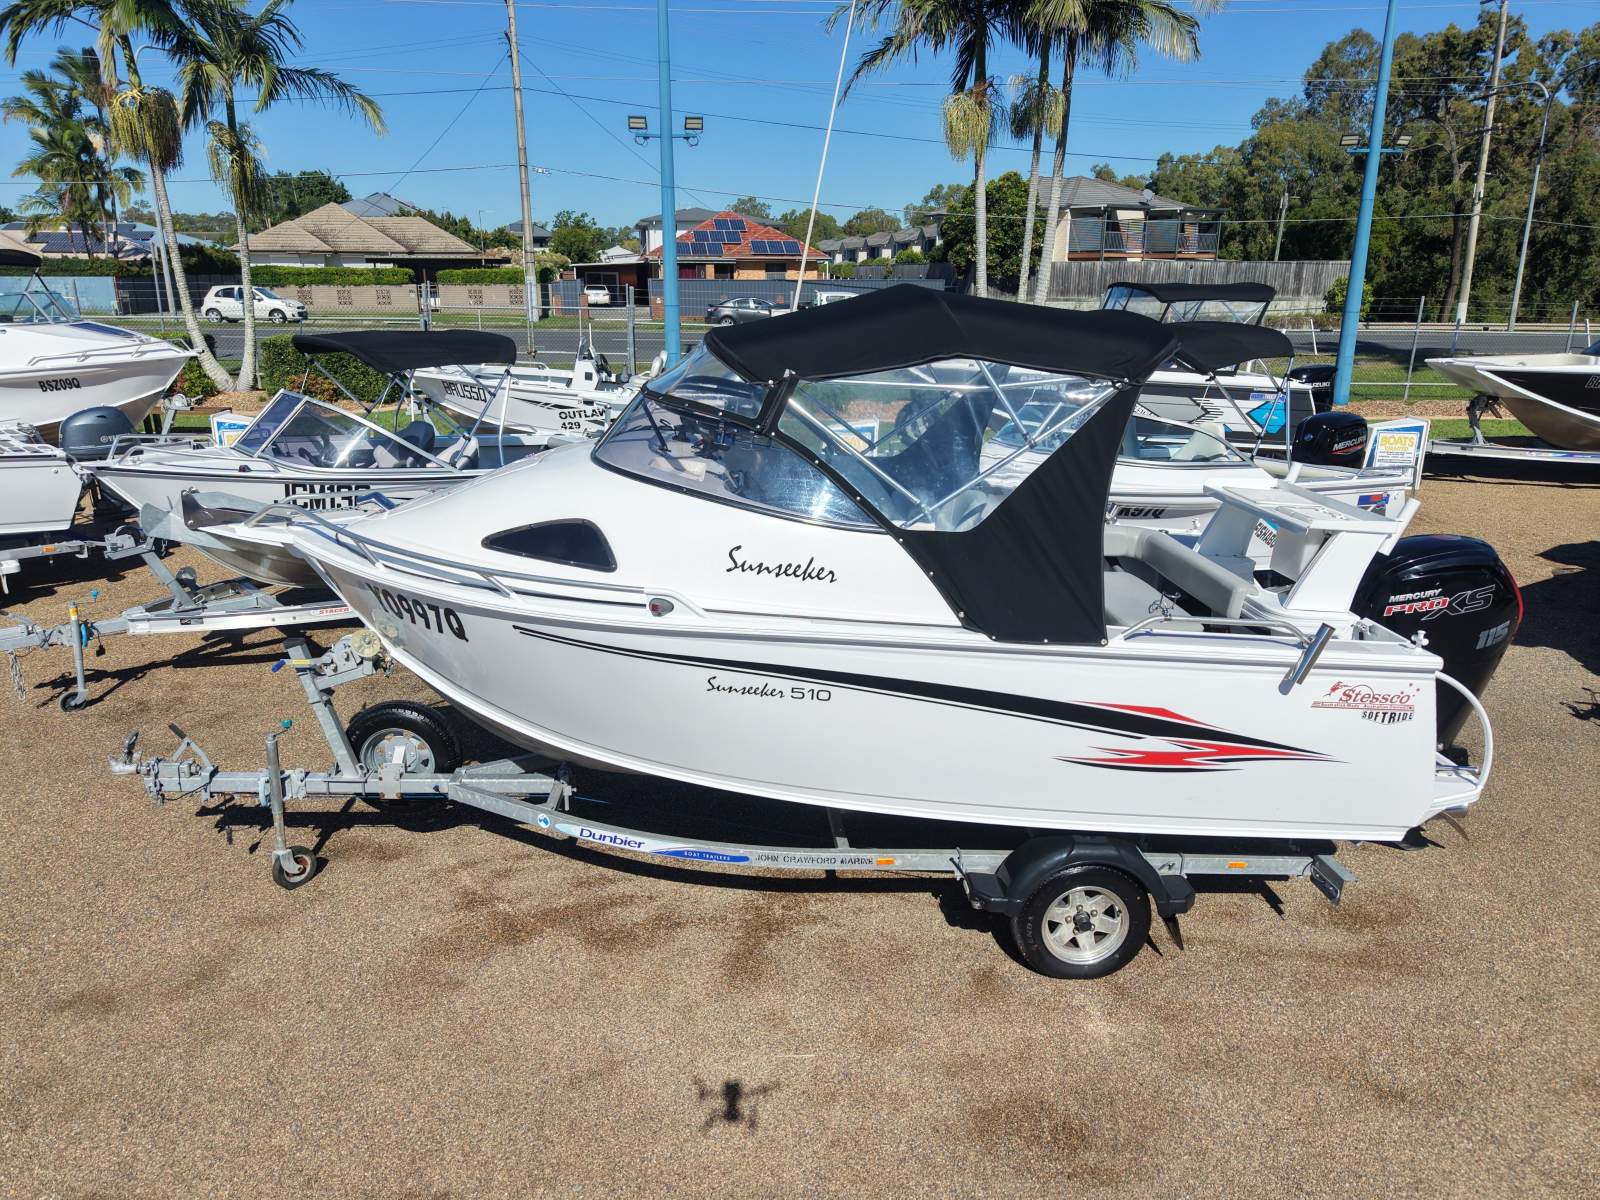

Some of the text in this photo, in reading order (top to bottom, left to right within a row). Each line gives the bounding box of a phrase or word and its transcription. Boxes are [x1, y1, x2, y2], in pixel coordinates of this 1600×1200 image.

[38, 377, 81, 392] BSZ09Q
[560, 421, 581, 430] 429
[726, 545, 837, 583] Sunseeker
[1388, 588, 1443, 603] MERCURY
[1475, 620, 1511, 650] 115
[706, 675, 832, 702] Sunseeker 510
[1339, 688, 1412, 705] Stessco
[1361, 710, 1414, 724] SOFTRIDE
[579, 827, 646, 849] Dunbier
[702, 852, 731, 861] TRAILERS
[755, 854, 779, 863] JOHN
